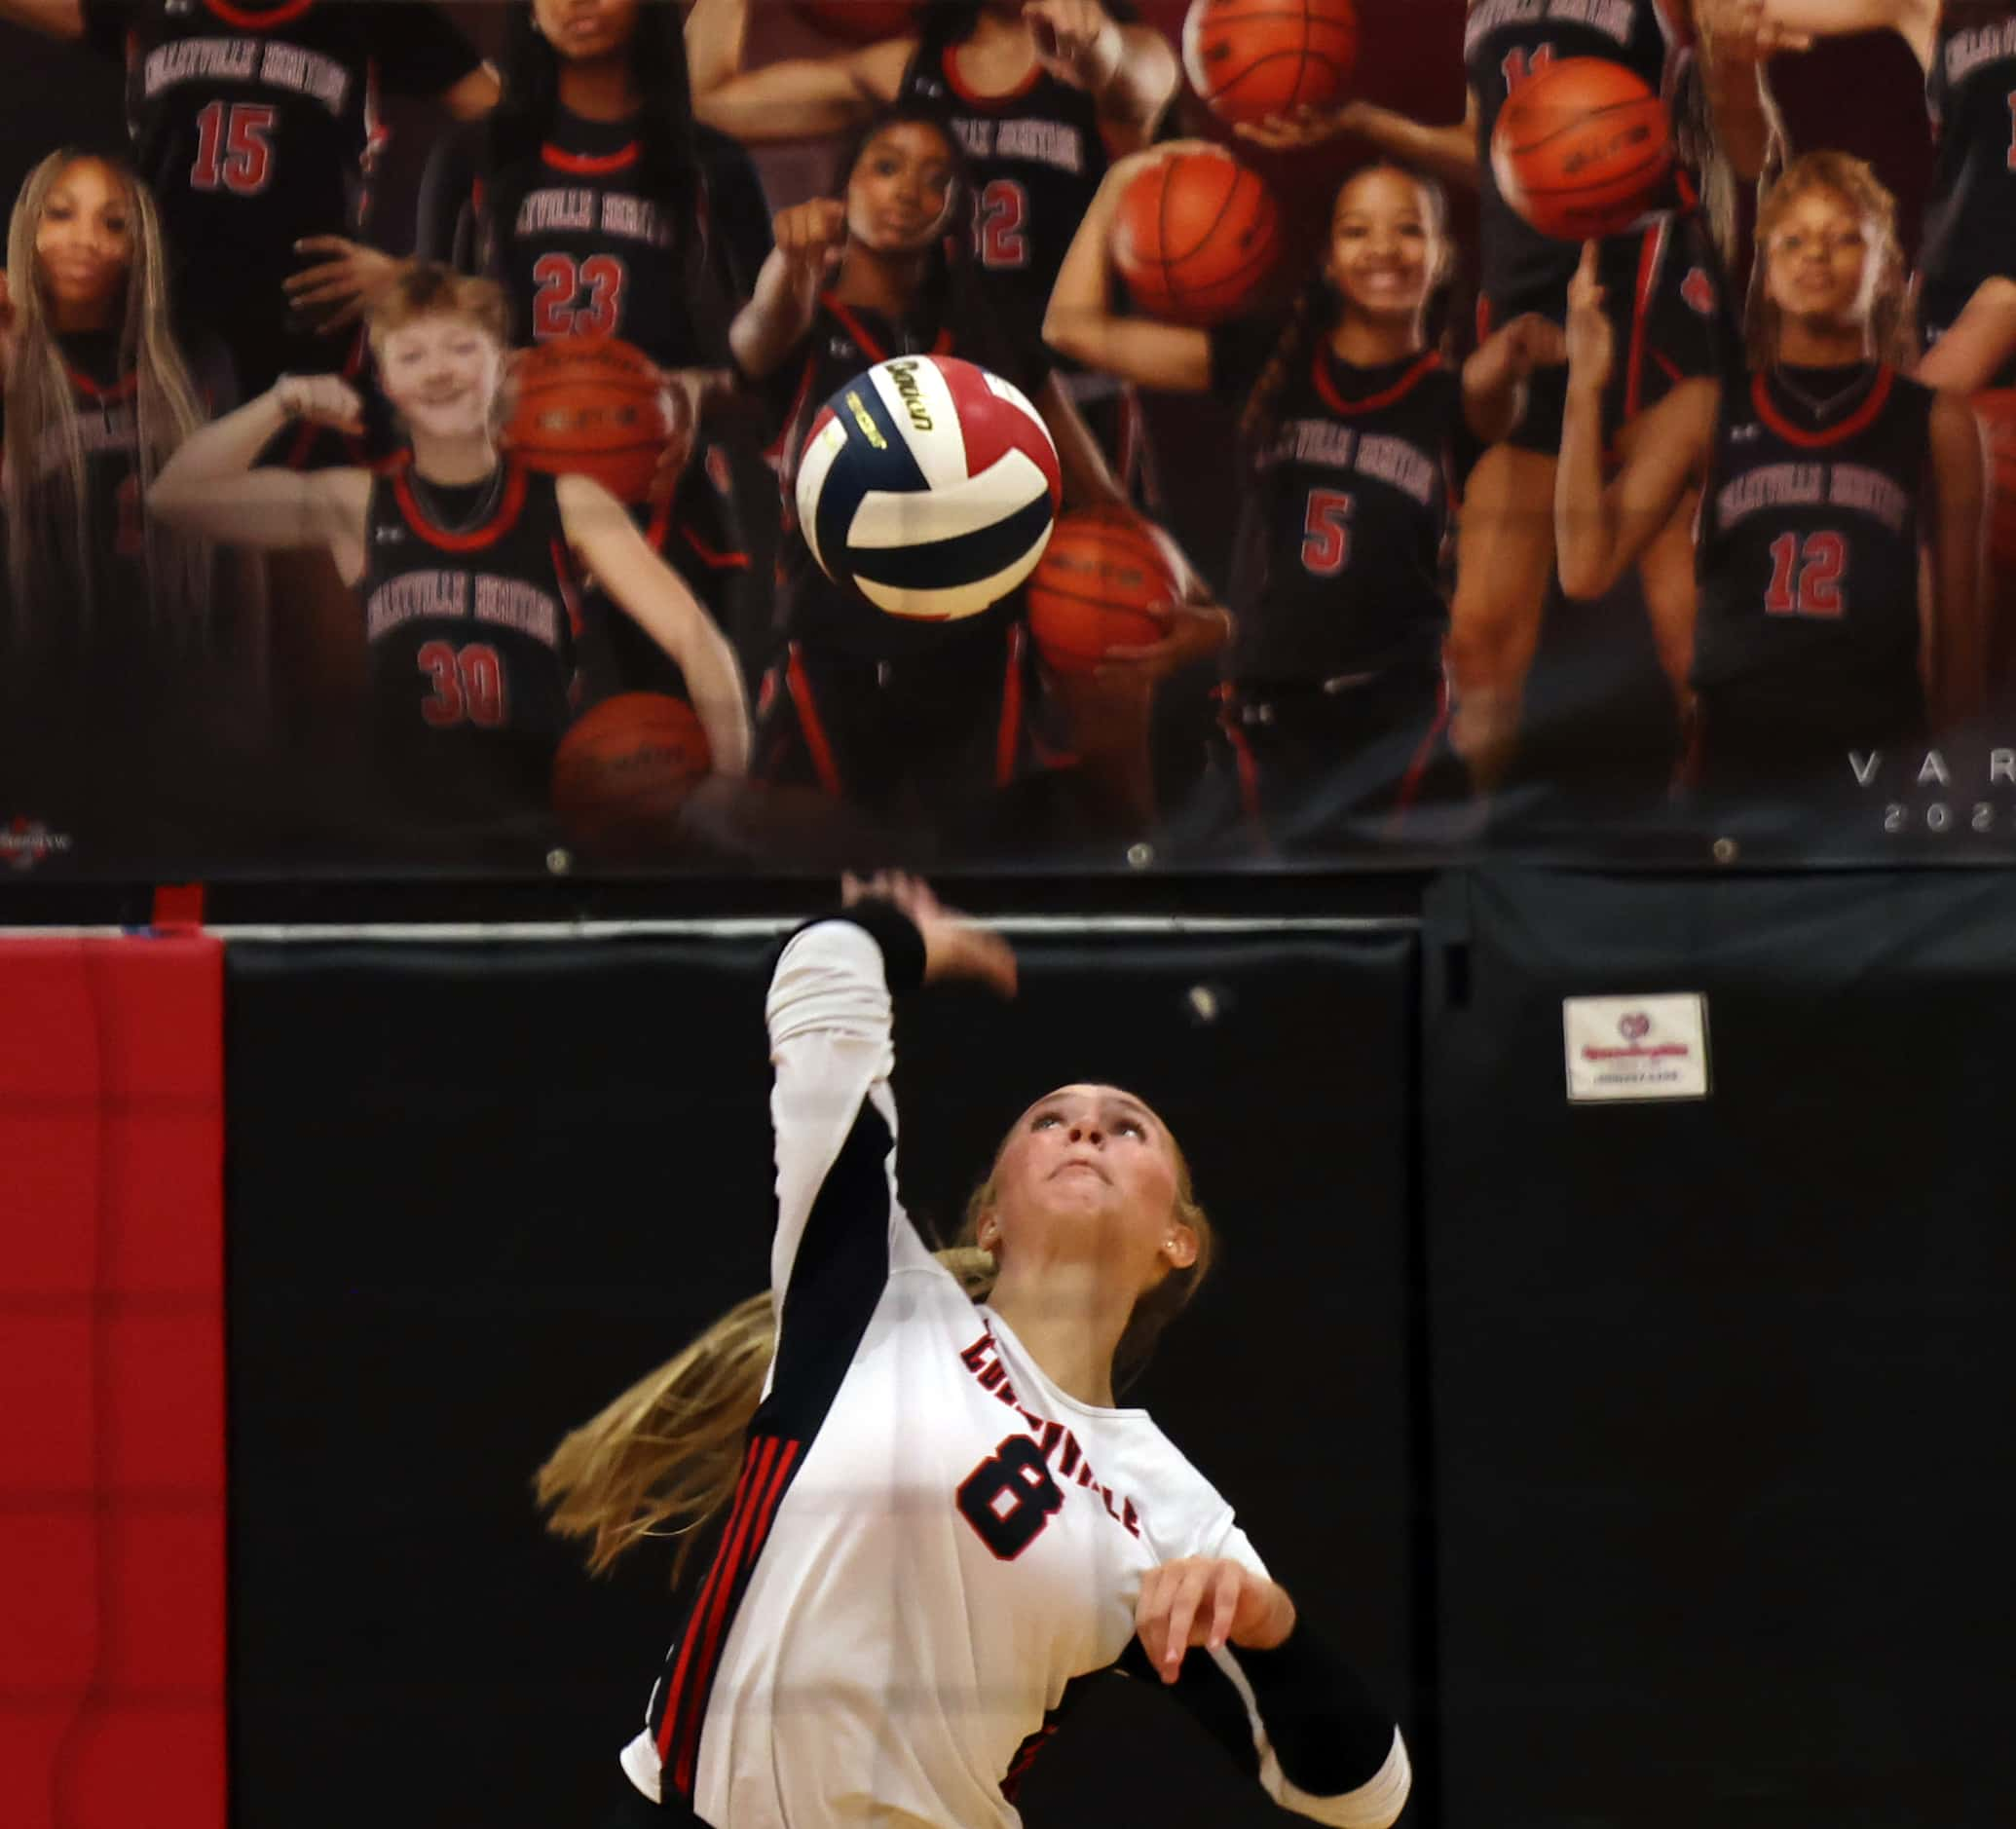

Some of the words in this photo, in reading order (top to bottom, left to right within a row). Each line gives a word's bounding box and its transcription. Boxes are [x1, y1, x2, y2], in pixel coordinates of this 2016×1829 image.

[190, 99, 275, 195] 15
[971, 178, 1026, 269] 2
[533, 251, 623, 337] 23
[1301, 488, 1352, 576] 5
[1764, 531, 1846, 618] 12
[417, 640, 504, 729] 30
[955, 1433, 1065, 1562] 8
